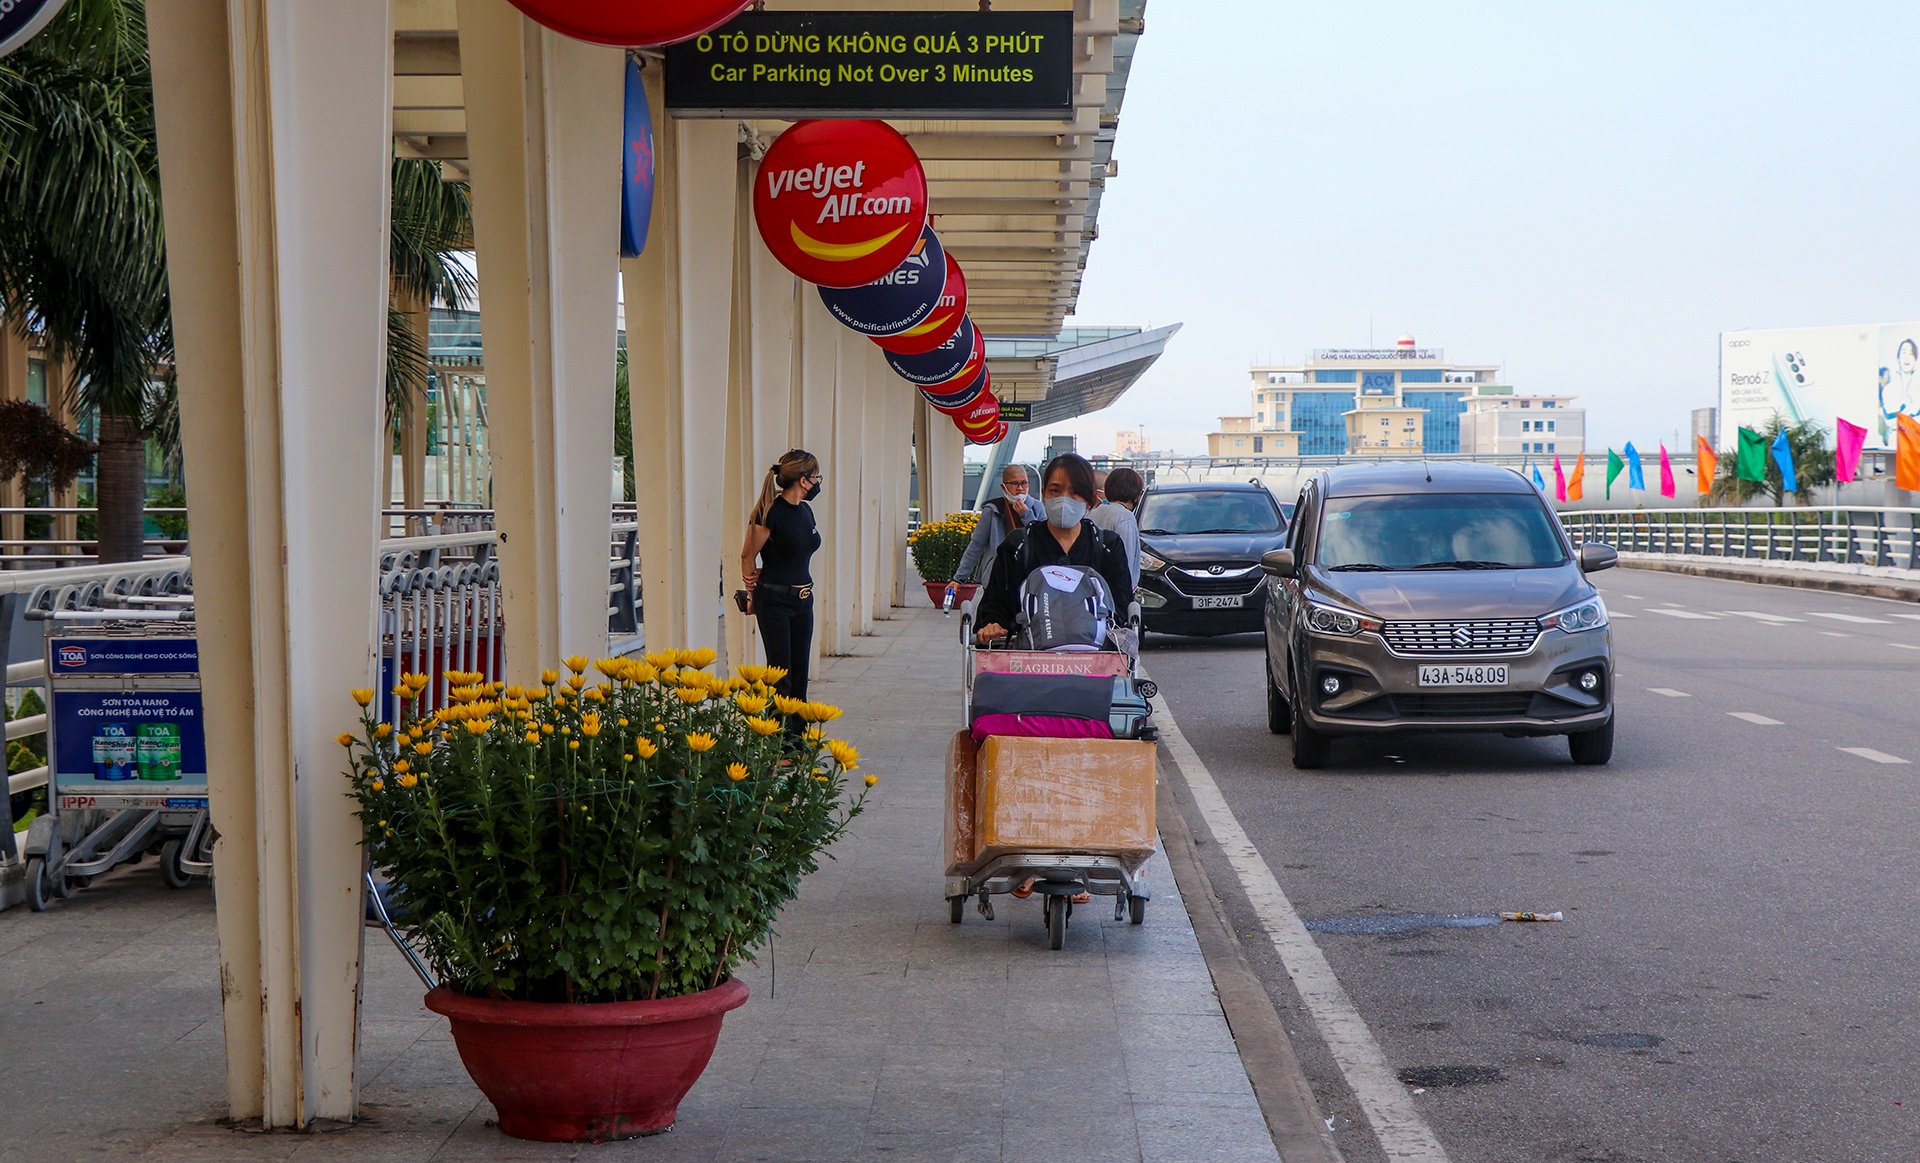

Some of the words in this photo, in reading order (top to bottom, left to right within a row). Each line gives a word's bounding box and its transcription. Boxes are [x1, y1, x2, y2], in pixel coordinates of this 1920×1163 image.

[719, 31, 749, 53] TÔ
[756, 32, 821, 53] DỪNG
[828, 32, 906, 53] KHÔNG
[913, 31, 961, 55] QUÁ
[967, 35, 979, 53] 3
[985, 31, 1044, 53] PHÚT
[710, 64, 746, 82] Car
[753, 64, 831, 86] Parking
[838, 64, 874, 82] Not
[879, 64, 929, 82] Over
[934, 64, 947, 82] 3
[953, 64, 1034, 82] Minutes
[816, 193, 911, 224] Air.com
[832, 302, 928, 331] www.pacificairlines.com
[892, 361, 960, 382] www.pacificairlines.com
[1363, 375, 1394, 387] ACV
[1731, 372, 1761, 385] Reno6
[1763, 371, 1770, 384] Z
[1198, 597, 1240, 608] 31F-2474
[61, 652, 84, 661] TOA
[105, 652, 124, 660] CÔNG
[1024, 663, 1092, 674] AGRIBANK
[1421, 668, 1506, 684] 43A-548.09
[102, 698, 122, 706] SƠN
[78, 708, 104, 716] CÔNG
[105, 708, 131, 718] NGHỆ
[132, 707, 151, 716] BẢO
[152, 708, 165, 718] VỆ
[103, 727, 126, 736] TOA
[147, 727, 170, 736] TOA
[139, 739, 180, 748] NanoClean
